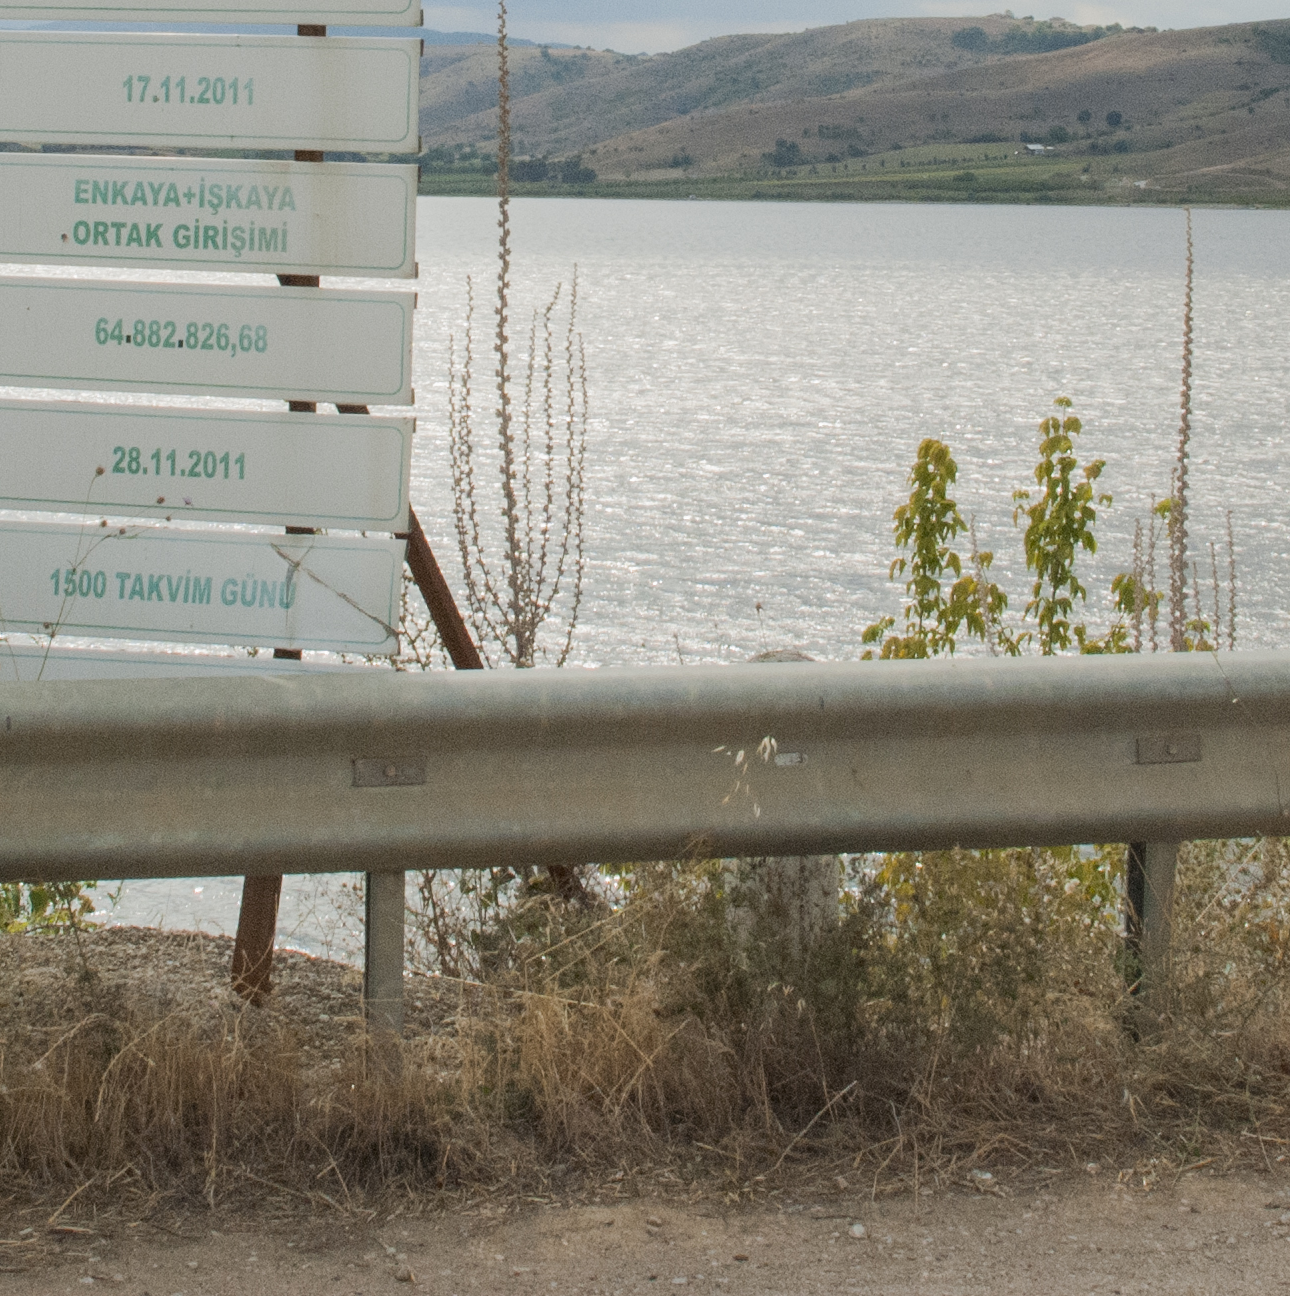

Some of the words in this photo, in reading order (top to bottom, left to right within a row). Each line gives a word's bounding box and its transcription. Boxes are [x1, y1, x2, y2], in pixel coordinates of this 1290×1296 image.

[123, 76, 255, 106] 17.11.2011
[74, 172, 297, 215] ENKAYA+İŞKAYA
[73, 222, 163, 248] ORTAK
[173, 216, 288, 257] GİRİŞİMİ
[95, 317, 268, 359] 64.882.826,68
[112, 446, 246, 480] 28.11.2011
[50, 567, 106, 599] 1500
[115, 568, 212, 605] TAKVİM
